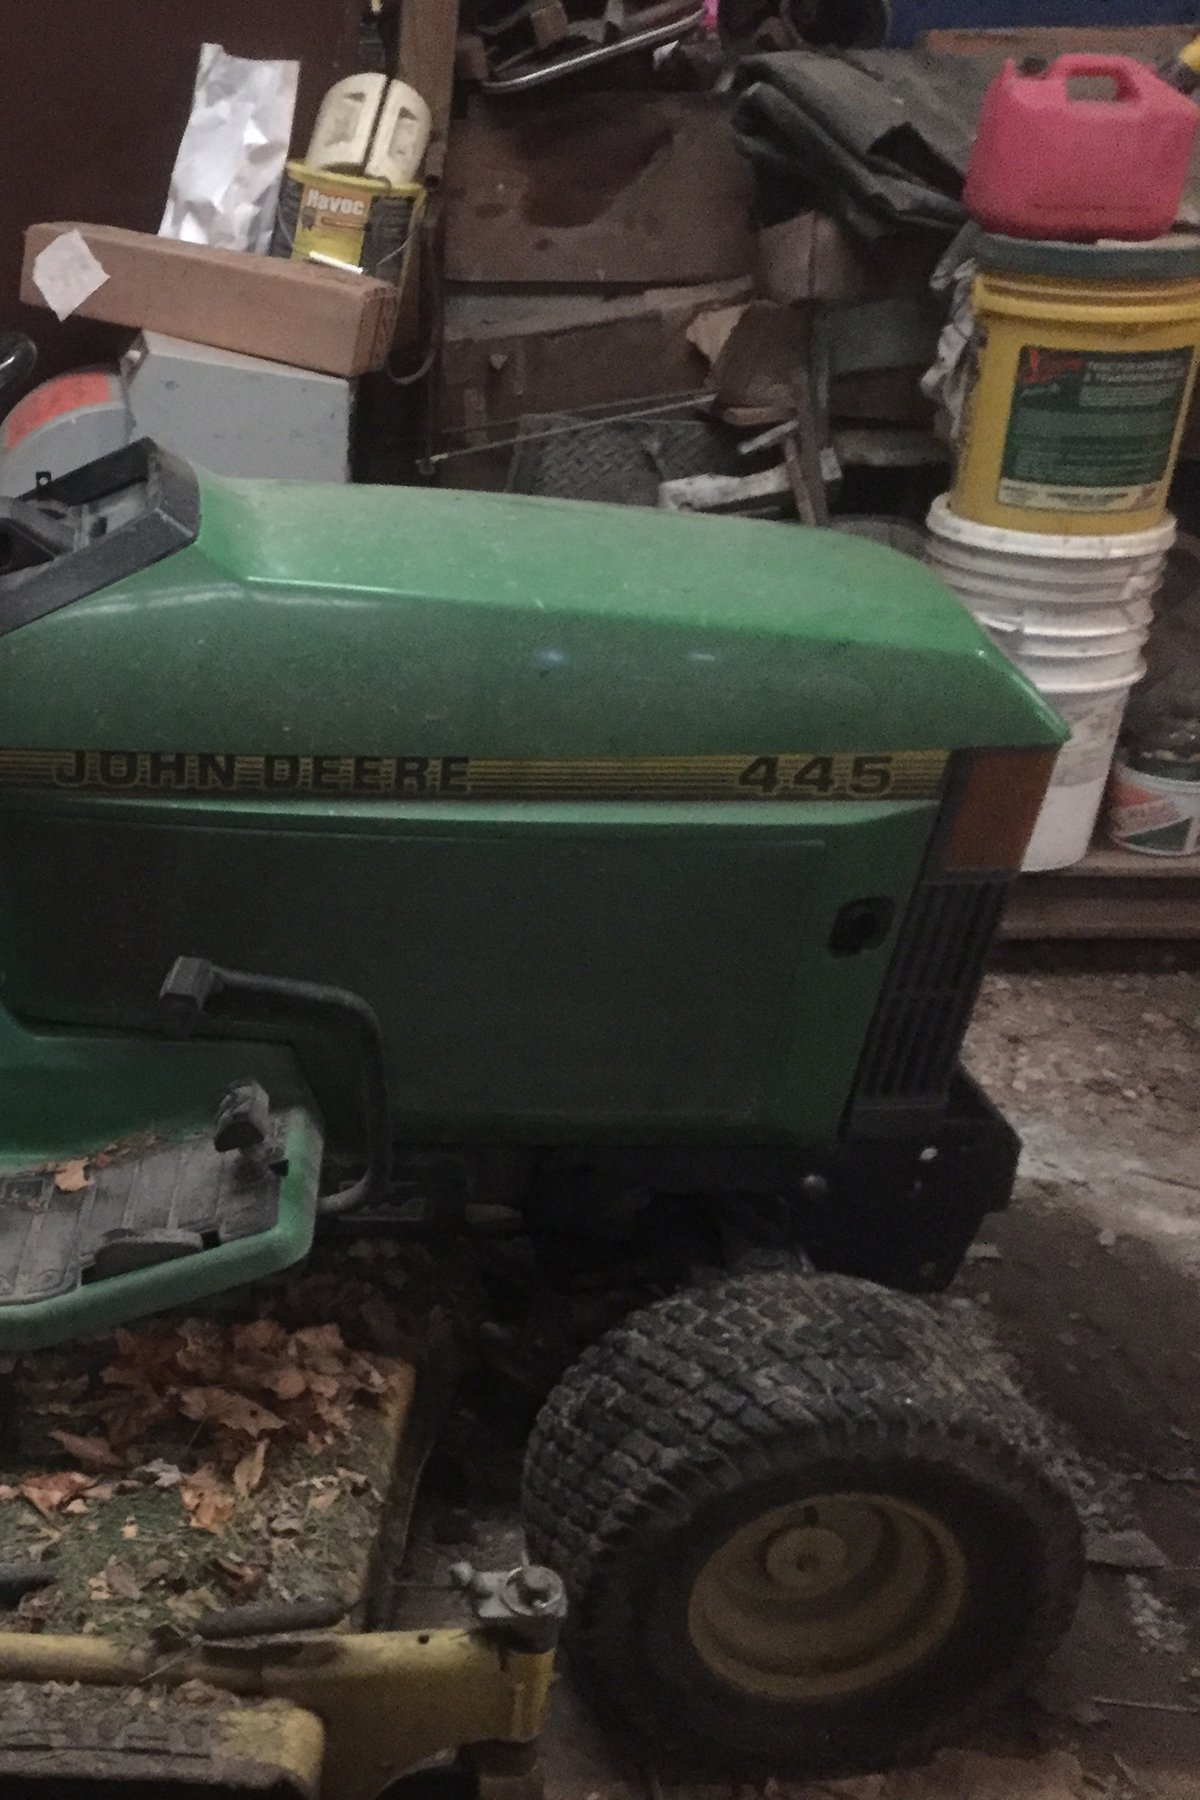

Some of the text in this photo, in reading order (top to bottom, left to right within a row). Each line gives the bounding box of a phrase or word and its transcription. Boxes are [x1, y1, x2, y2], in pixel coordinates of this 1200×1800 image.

[306, 188, 365, 215] Havoc
[53, 750, 470, 793] JOHN DEERE
[738, 756, 894, 793] 445
